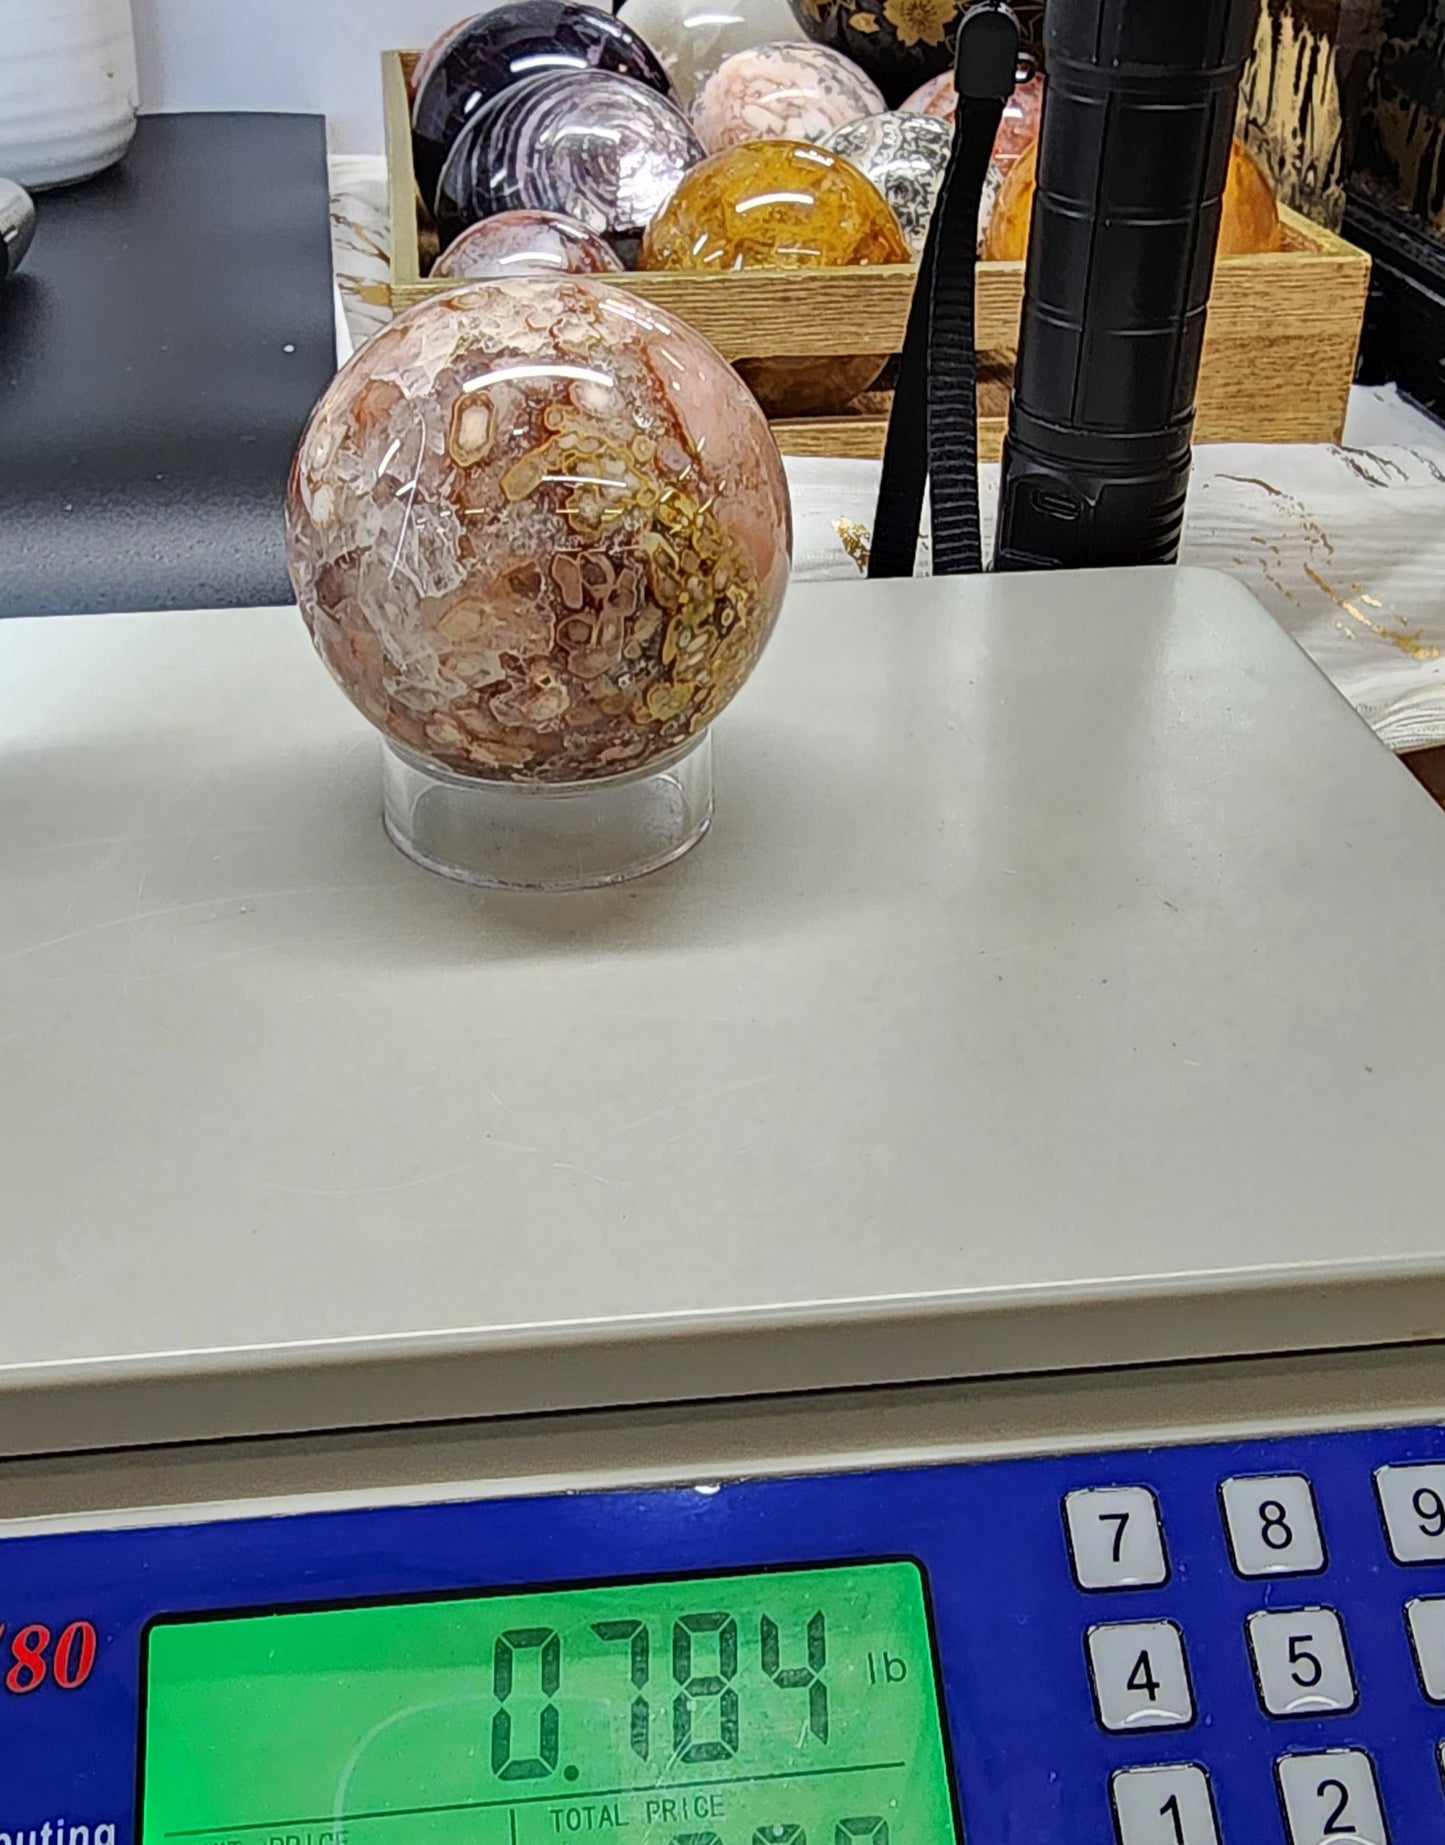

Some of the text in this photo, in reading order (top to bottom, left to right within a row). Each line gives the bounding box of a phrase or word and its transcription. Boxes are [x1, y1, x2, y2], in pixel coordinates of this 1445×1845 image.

[1098, 1512, 1130, 1562] 7
[1258, 1500, 1293, 1550] 8
[1411, 1487, 1445, 1536] 9
[0, 1620, 97, 1694] 80
[1126, 1649, 1160, 1701] 4
[1287, 1634, 1323, 1687] 5
[491, 1609, 907, 1782] 0.784 lb
[0, 1817, 116, 1845] uting
[549, 1794, 726, 1833] TOTAL PRICE
[1159, 1794, 1184, 1845] 1
[1316, 1778, 1357, 1836] 2
